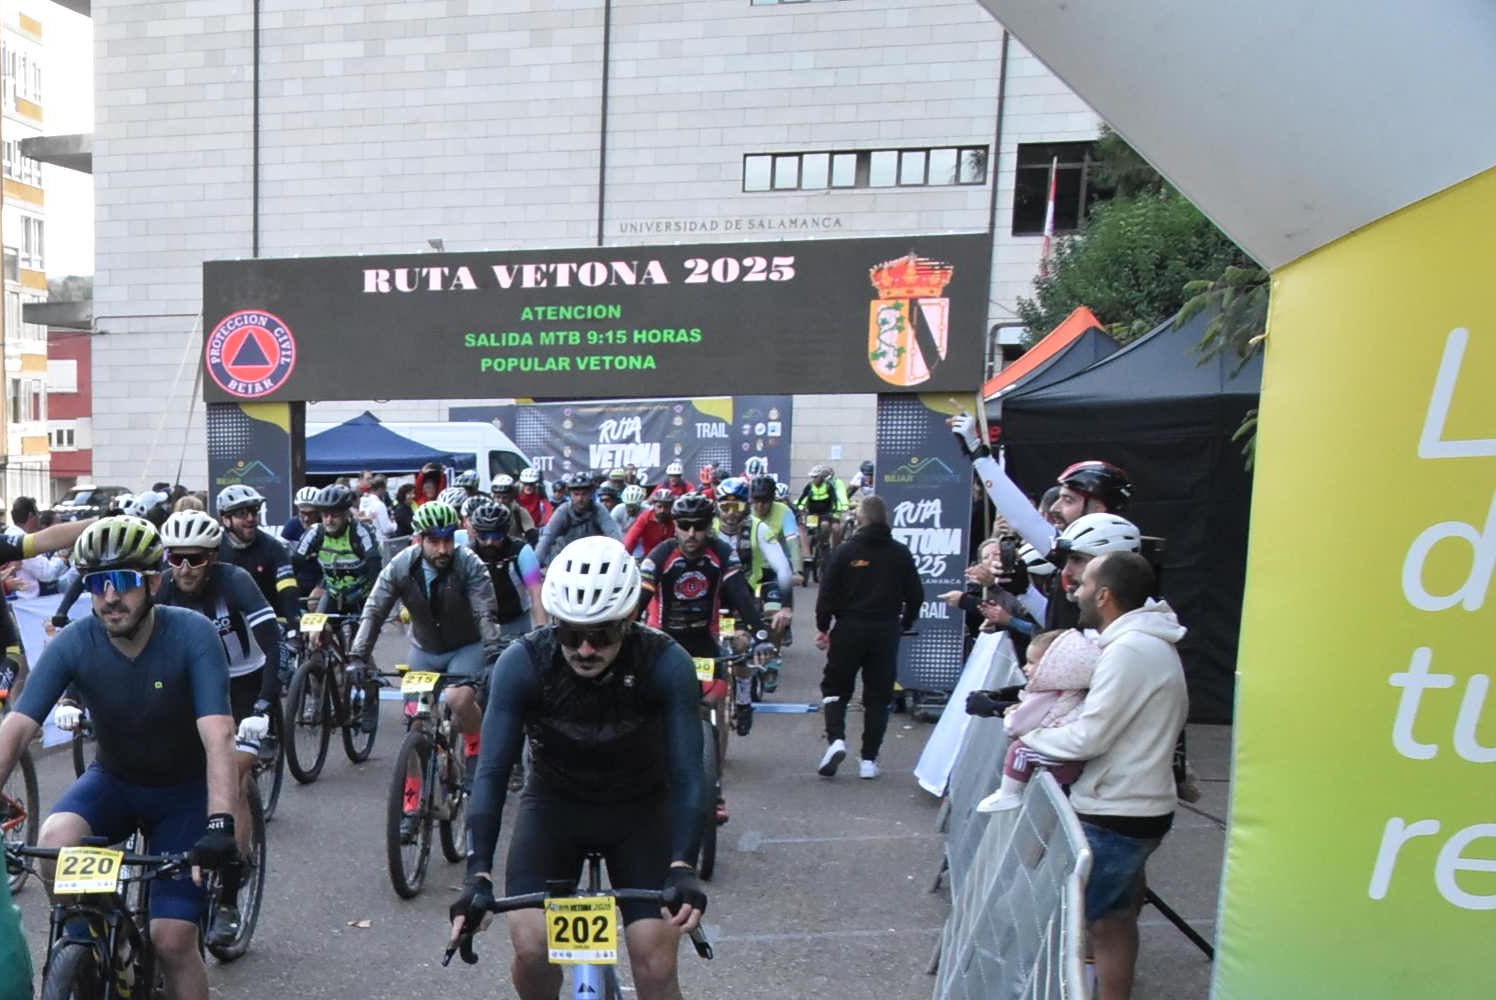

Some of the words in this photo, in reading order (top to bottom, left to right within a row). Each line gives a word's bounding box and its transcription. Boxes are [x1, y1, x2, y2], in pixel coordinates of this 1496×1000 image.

[619, 220, 719, 234] UNIVERSIDAD
[724, 219, 742, 232] DE
[747, 216, 844, 231] SALAMANCA
[361, 265, 479, 294] RUTA
[491, 259, 670, 290] VETONA
[682, 255, 797, 285] 2025
[519, 304, 622, 322] ATENCION
[210, 314, 269, 365] PROTECCION
[273, 327, 293, 365] CIVIL
[464, 332, 534, 349] SALIDA
[539, 331, 581, 346] MTB
[586, 329, 627, 345] 9:15
[632, 327, 702, 344] HORAS
[480, 356, 571, 373] POPULAR
[575, 354, 657, 371] VETONA
[227, 377, 275, 395] BEJAR
[1417, 327, 1496, 460] L
[598, 416, 642, 443] RUTA
[695, 422, 730, 438] TRAIL
[589, 443, 661, 470] VETONA
[893, 499, 943, 529] RUTA
[1401, 484, 1496, 612] d
[918, 602, 950, 620] RAIL
[62, 856, 114, 875] 220
[1368, 816, 1496, 911] re
[553, 915, 610, 944] 202
